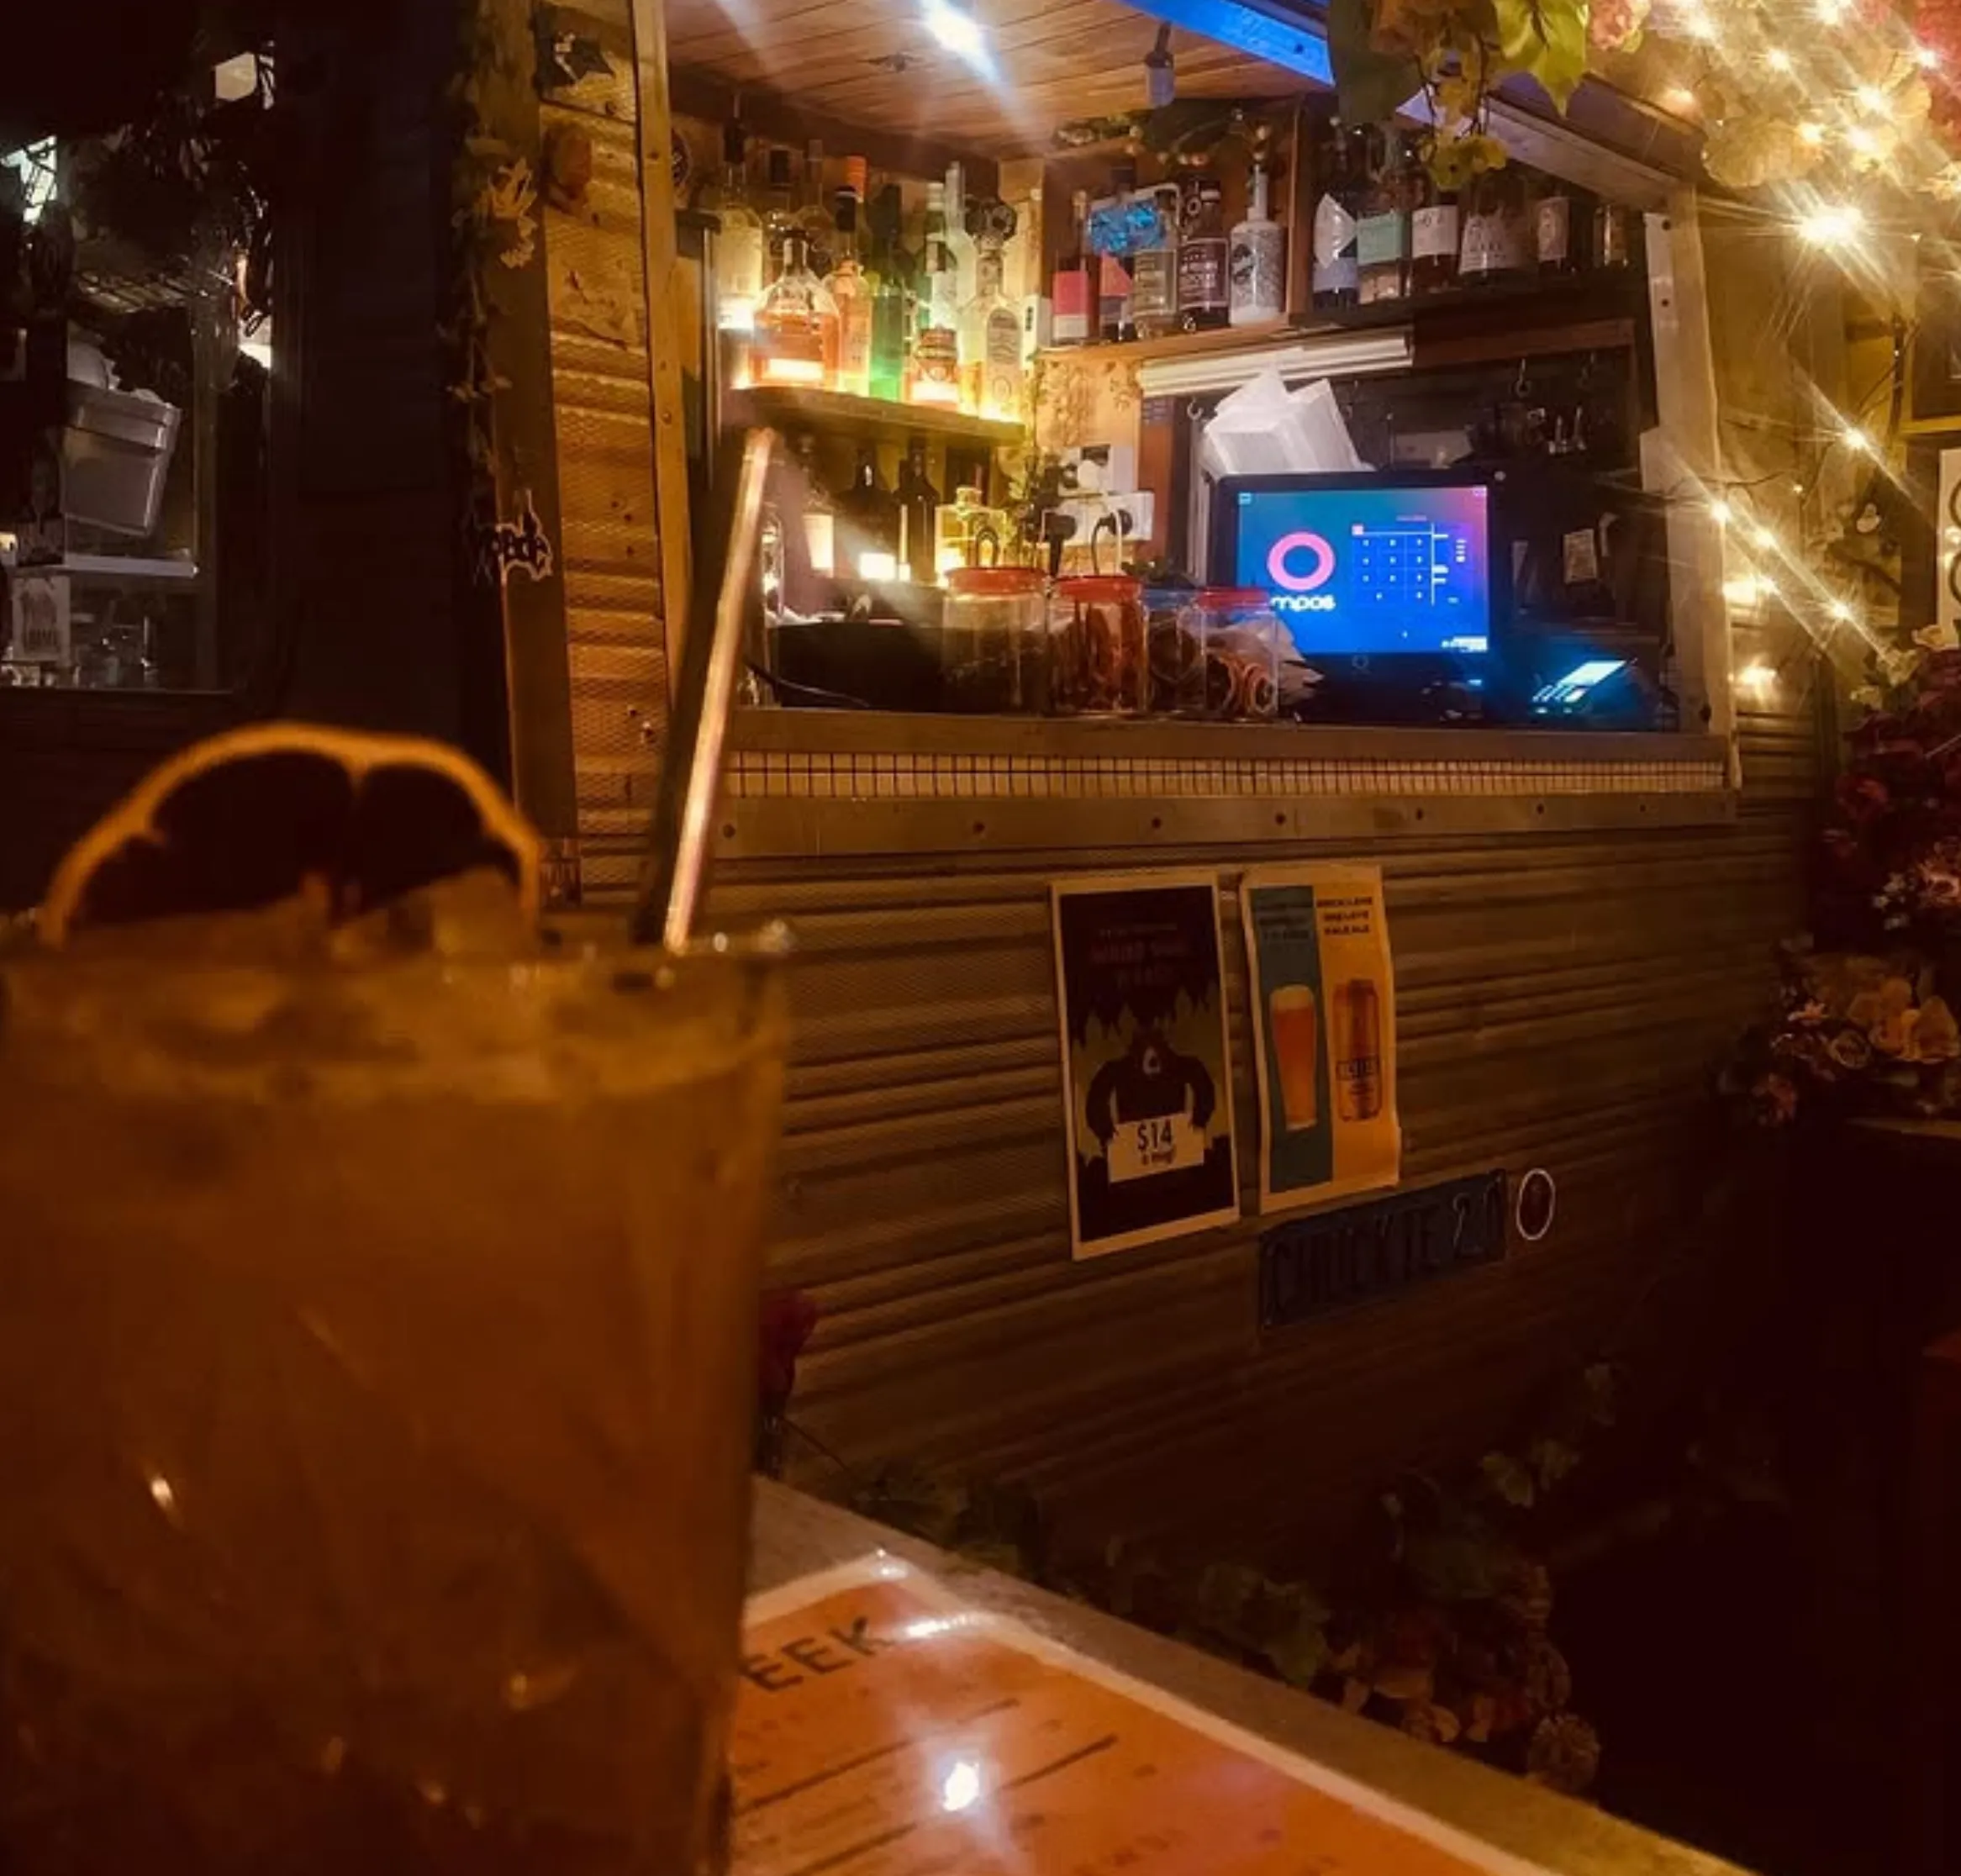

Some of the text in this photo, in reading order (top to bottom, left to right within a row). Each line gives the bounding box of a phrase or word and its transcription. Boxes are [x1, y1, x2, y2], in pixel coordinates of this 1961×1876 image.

[1270, 595, 1336, 612] mpos
[1136, 1119, 1173, 1151] $14
[739, 1615, 894, 1691] EEK
